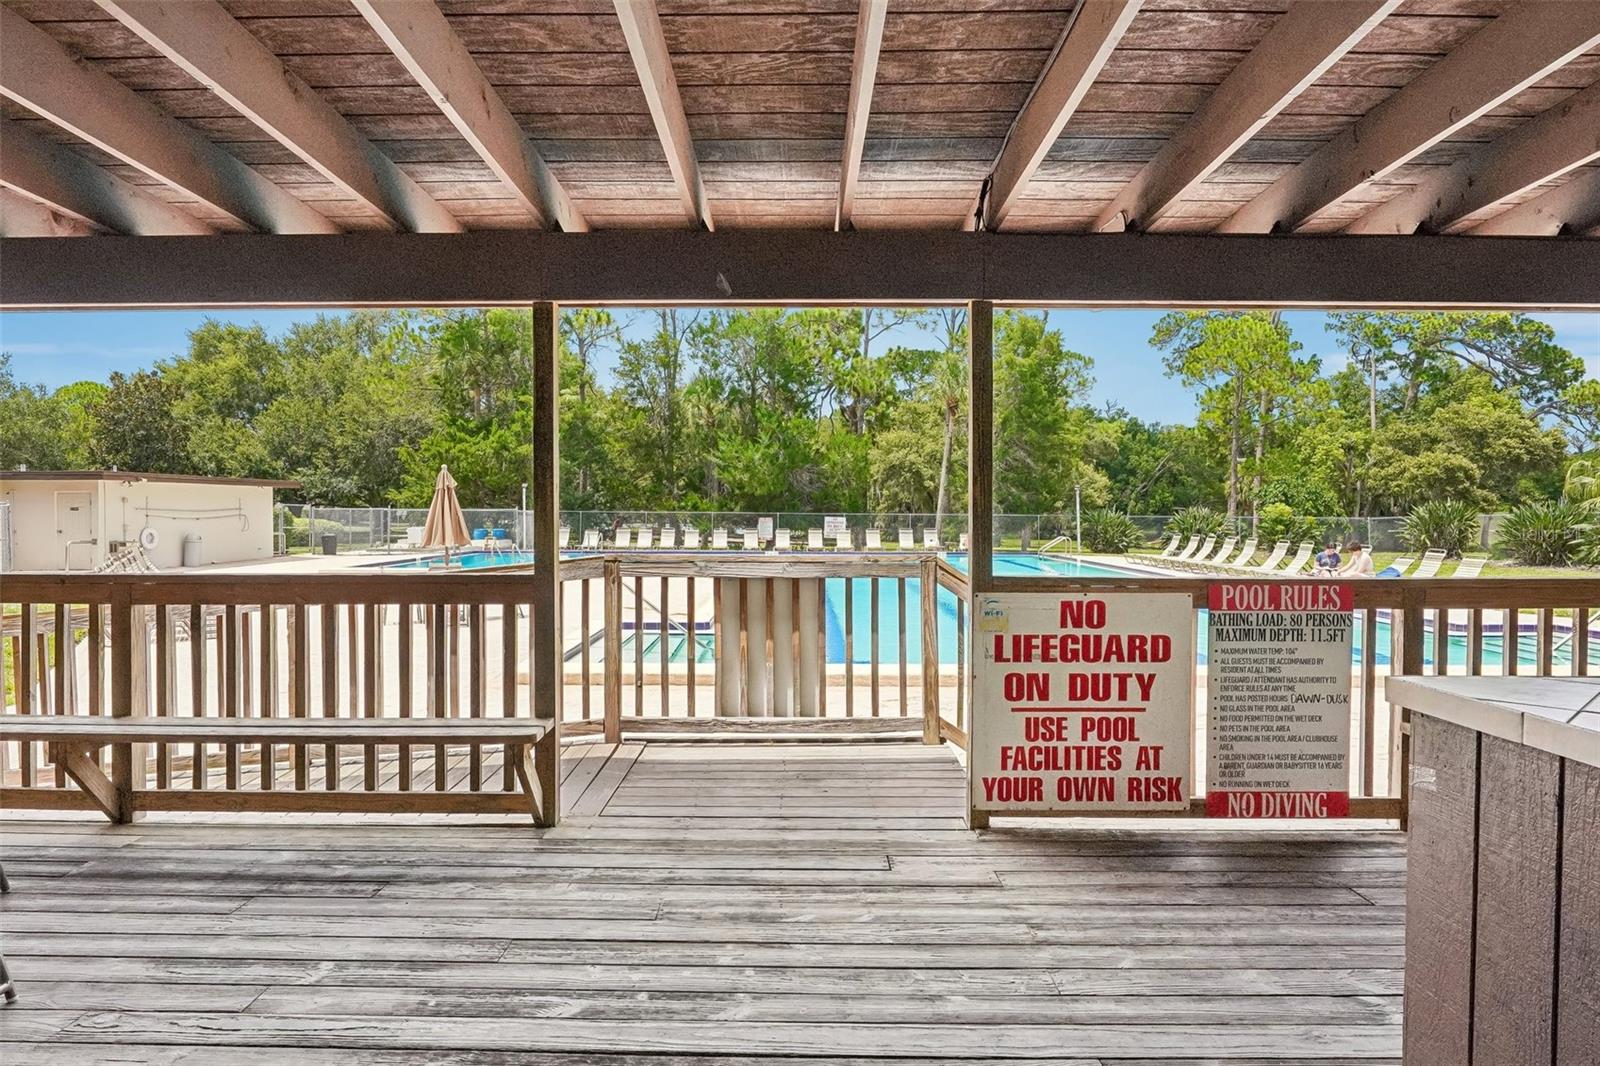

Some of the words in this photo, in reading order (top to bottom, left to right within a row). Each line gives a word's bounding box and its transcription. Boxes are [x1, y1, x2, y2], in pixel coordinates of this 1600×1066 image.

[1222, 585, 1274, 610] POOL
[1280, 585, 1340, 610] RULES
[1060, 600, 1106, 629] NO
[1210, 613, 1252, 626] BATHING
[1256, 613, 1286, 626] LOAD:
[1290, 613, 1302, 626] 80
[1306, 613, 1352, 626] PERSONS
[1216, 629, 1265, 642] MAXIMUM
[1270, 629, 1306, 642] DEPTH:
[1311, 629, 1345, 642] 11.5FT
[994, 634, 1171, 663] LIFEGUARD
[1004, 673, 1049, 701] ON
[1068, 673, 1156, 701] DUTY
[1025, 717, 1067, 742] USE
[1081, 717, 1140, 742] POOL
[1001, 746, 1121, 771] FACILITIES
[1136, 746, 1163, 771] AT
[982, 776, 1044, 802] YOUR
[1058, 776, 1113, 802] OWN
[1128, 776, 1182, 802] RISK
[1228, 793, 1255, 817] NO
[1261, 793, 1328, 817] DIVING
